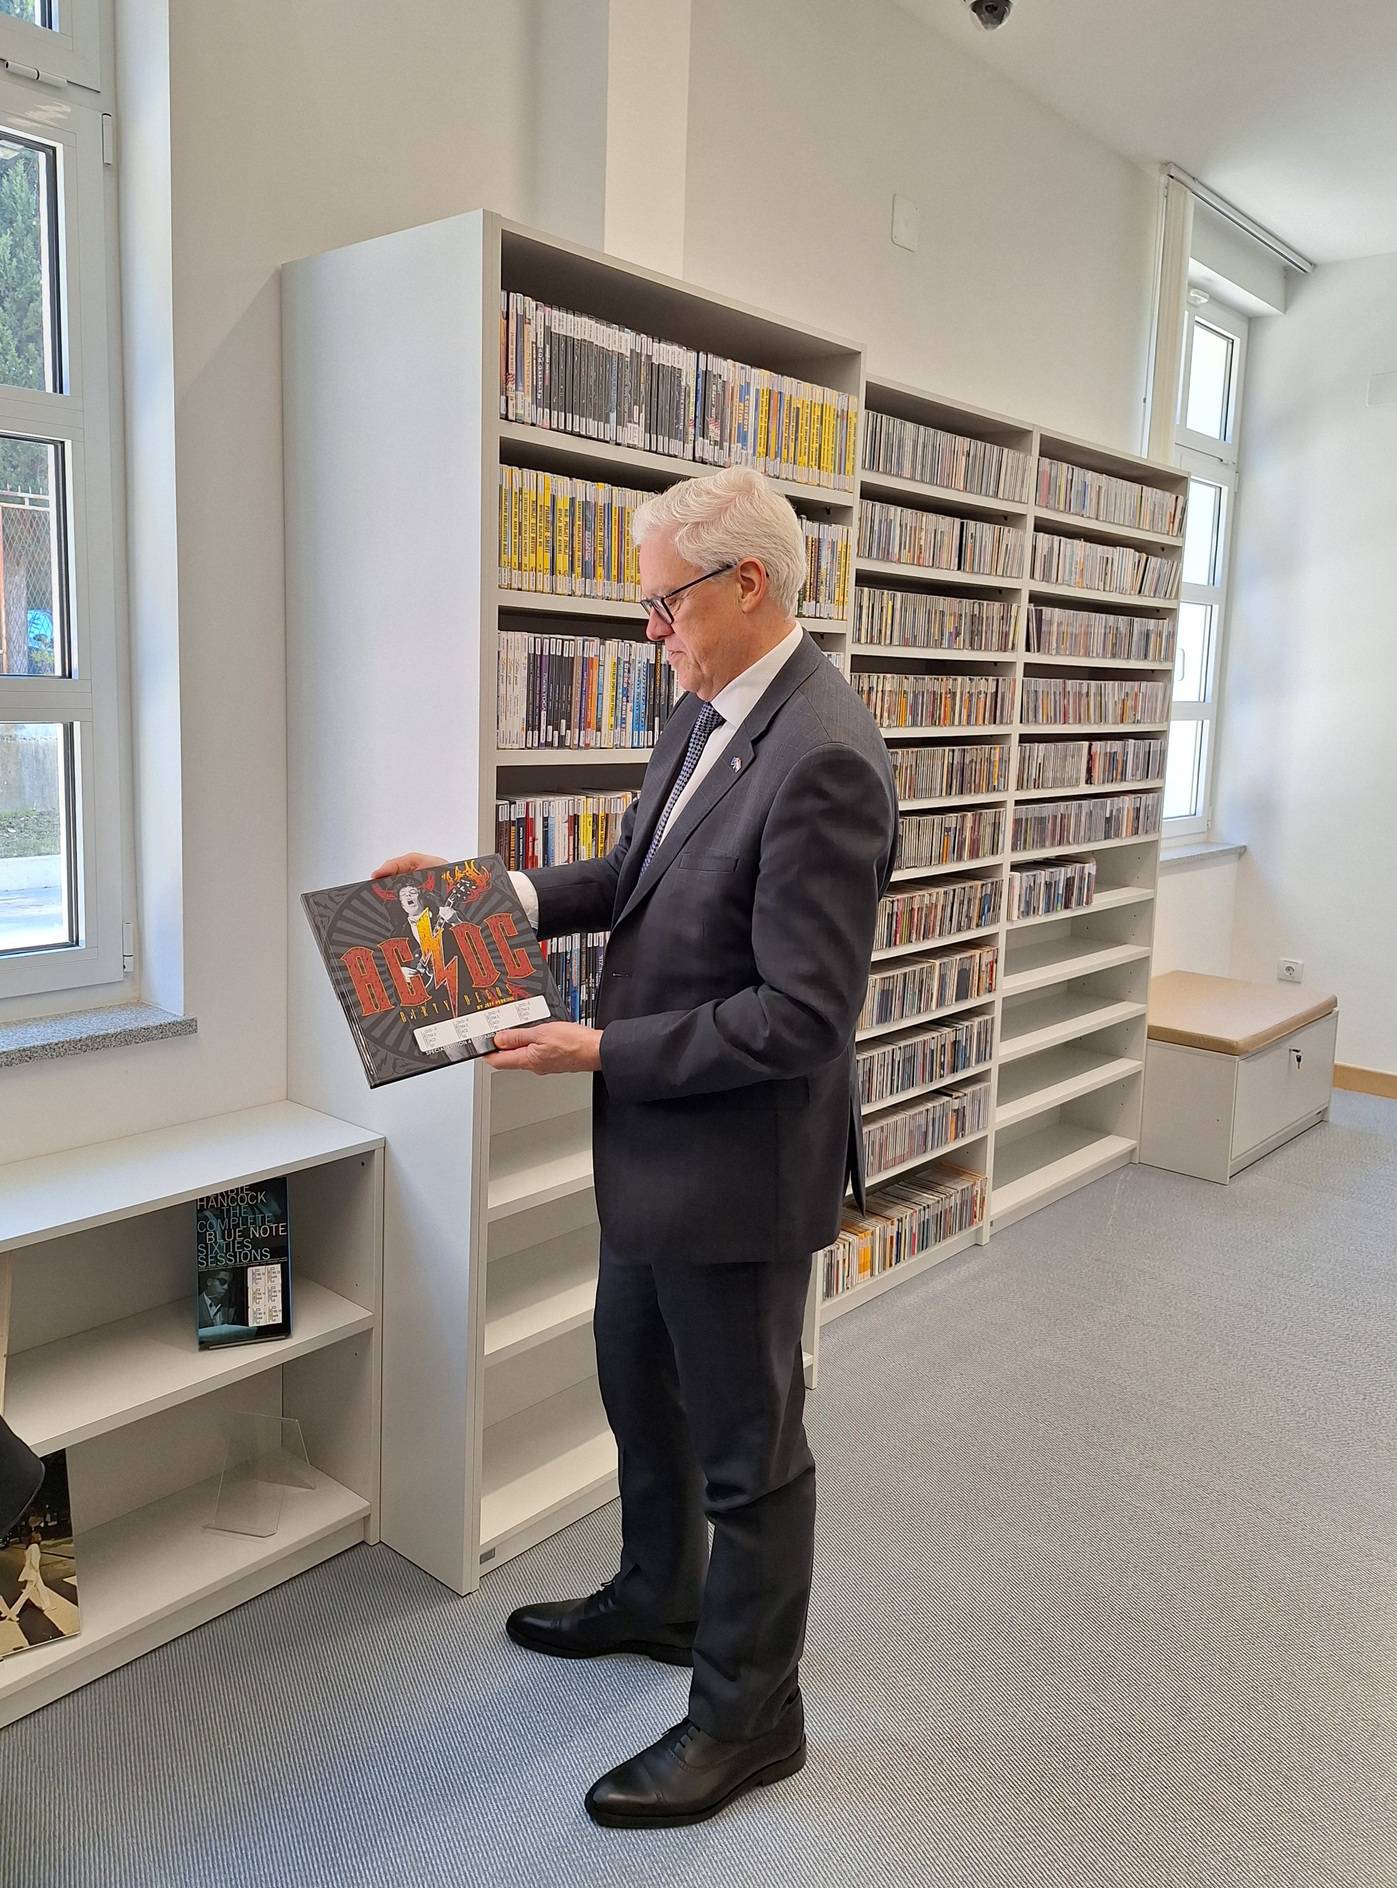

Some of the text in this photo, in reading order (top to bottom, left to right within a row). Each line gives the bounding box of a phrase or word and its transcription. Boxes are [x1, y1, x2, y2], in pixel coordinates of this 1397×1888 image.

[197, 1191, 267, 1210] HANCOCK
[222, 1204, 248, 1218] THE
[197, 1213, 273, 1233] COMPLETE
[206, 1223, 287, 1244] BLUE NOTE
[198, 1238, 252, 1256] SIXTIES
[198, 1247, 271, 1268] SESSIONS
